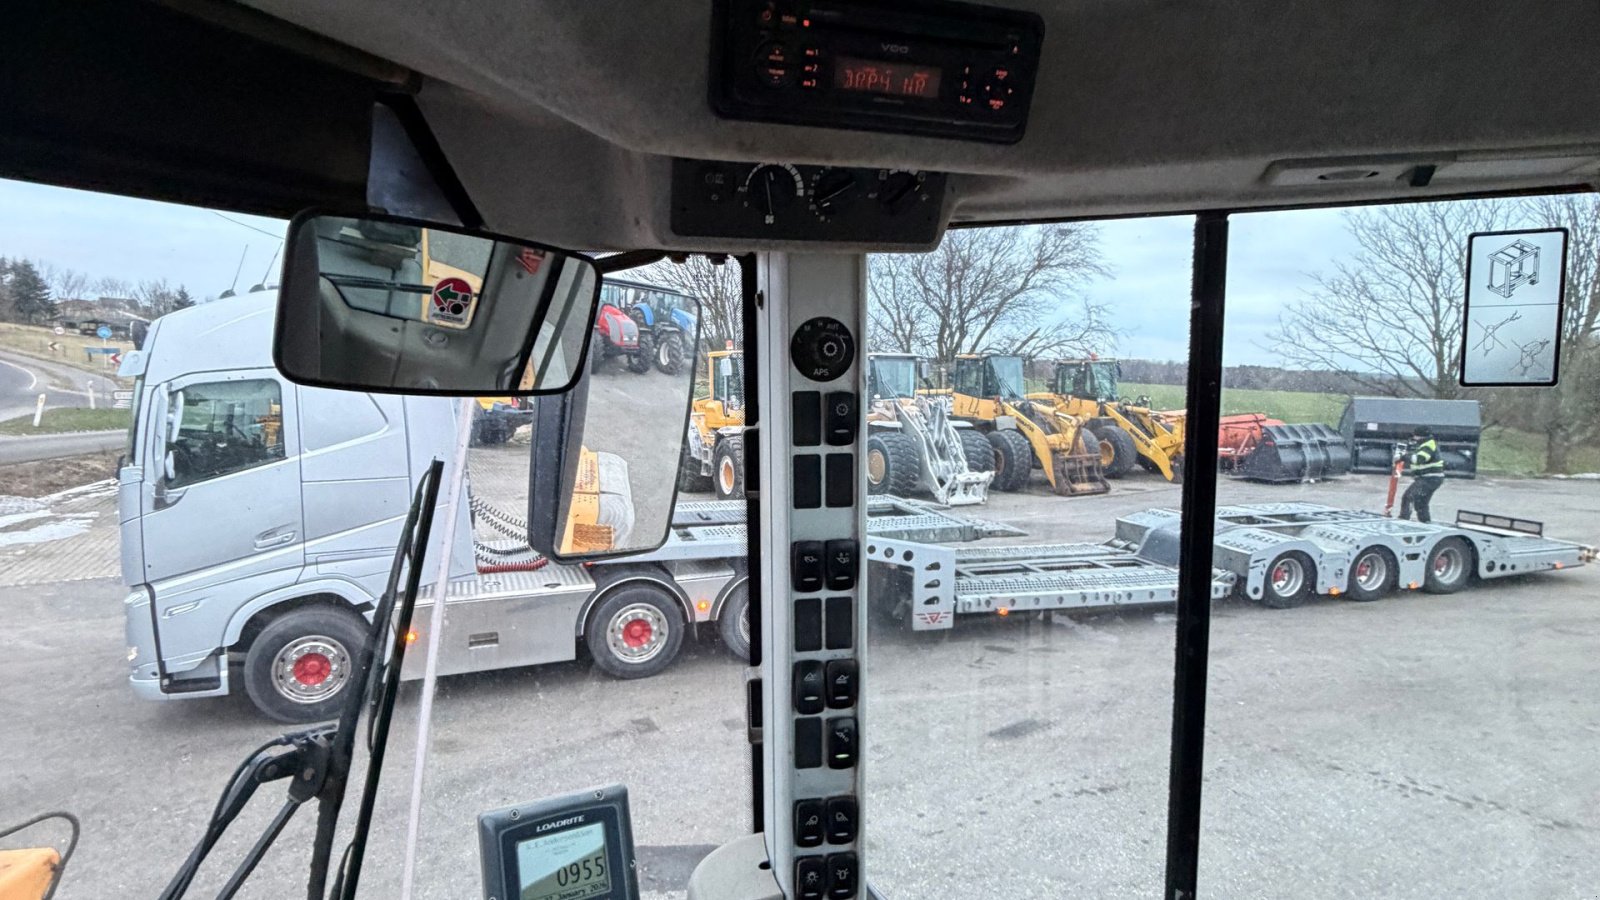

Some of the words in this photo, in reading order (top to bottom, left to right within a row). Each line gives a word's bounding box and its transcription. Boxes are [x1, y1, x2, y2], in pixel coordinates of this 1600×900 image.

[813, 368, 829, 376] APS
[536, 814, 585, 833] LOADRITE
[556, 856, 605, 887] 0955
